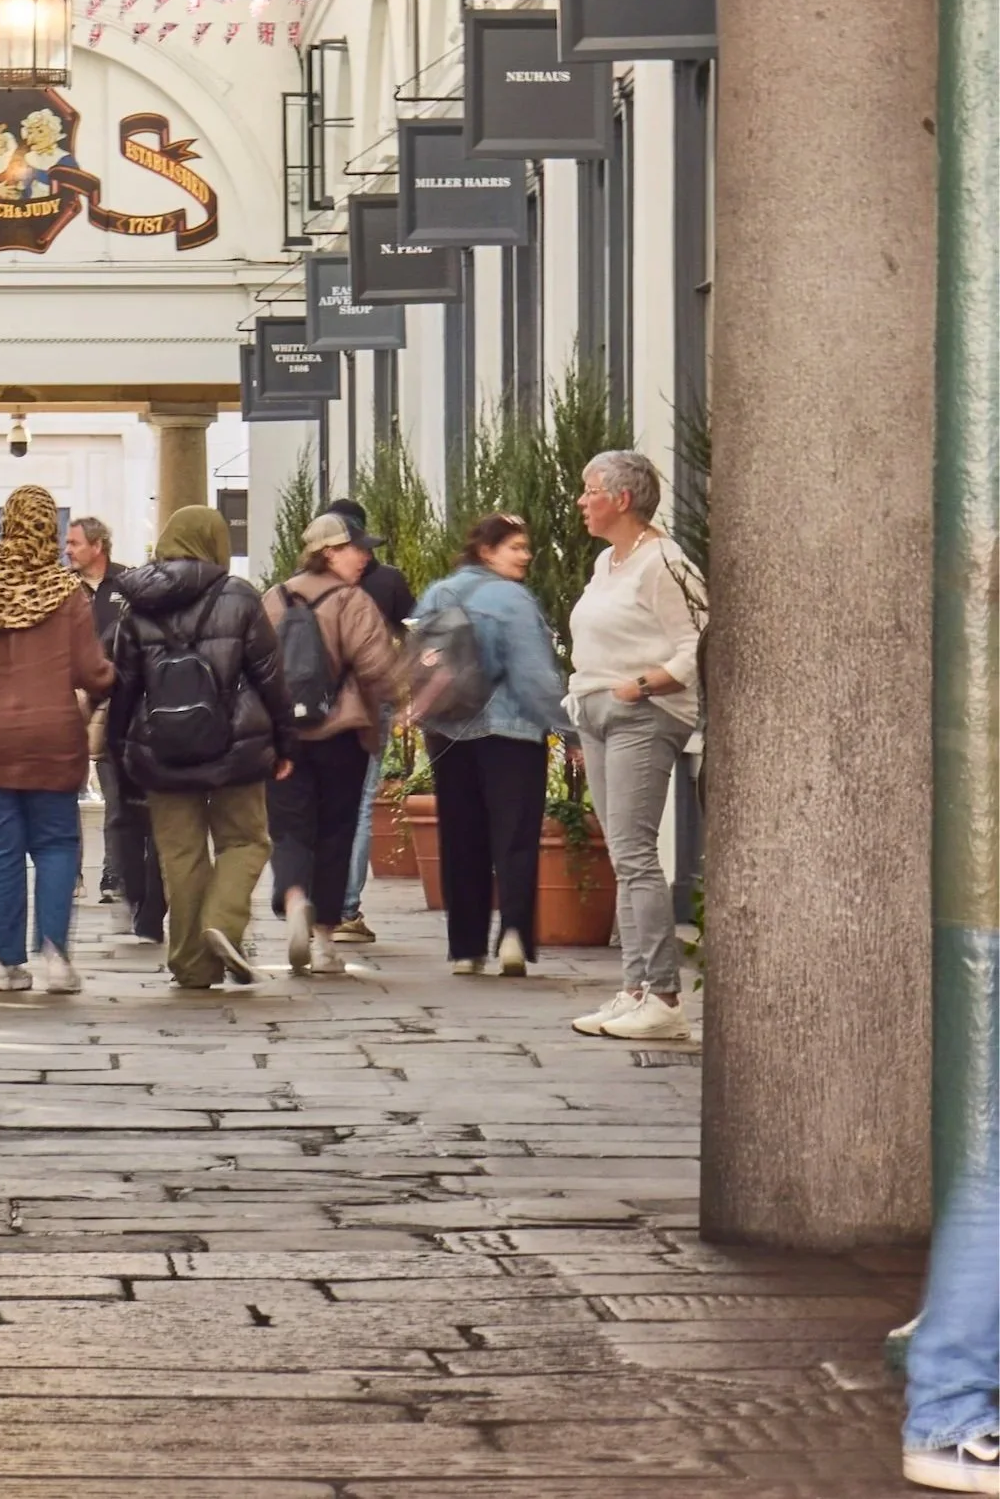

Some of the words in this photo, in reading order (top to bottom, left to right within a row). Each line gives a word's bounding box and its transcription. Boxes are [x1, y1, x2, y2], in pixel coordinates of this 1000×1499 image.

[505, 71, 571, 82] NEUHAUS
[125, 140, 209, 204] ESTABLISHED
[415, 178, 462, 189] MILLER
[464, 177, 511, 188] HARRIS
[128, 216, 163, 234] 1787
[275, 354, 323, 363] CHELSEA
